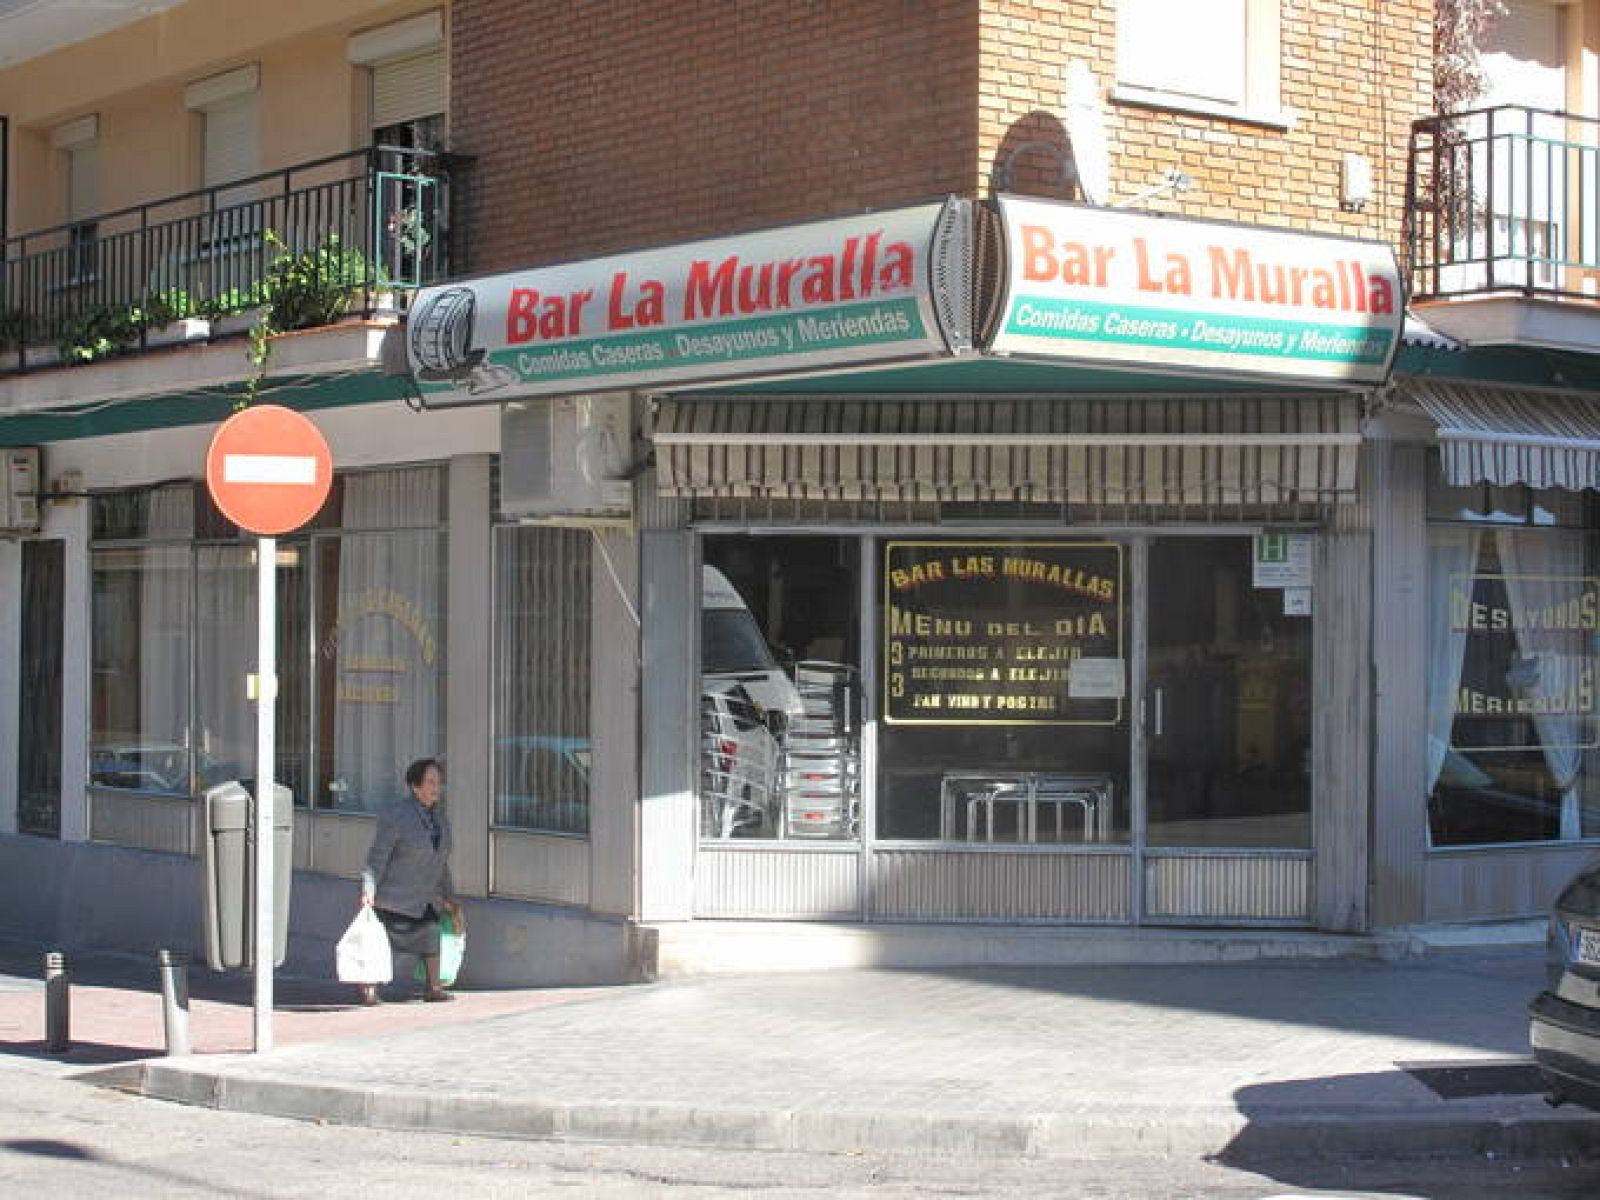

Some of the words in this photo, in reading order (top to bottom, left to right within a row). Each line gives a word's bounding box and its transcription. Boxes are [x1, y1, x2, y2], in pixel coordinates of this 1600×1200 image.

[507, 286, 593, 344] Bar
[608, 272, 664, 329] La
[685, 229, 914, 320] Muralla
[1021, 226, 1114, 288] Bar
[1134, 238, 1192, 295] La
[1208, 246, 1393, 315] Muralla
[519, 350, 589, 375] Comidas
[593, 340, 663, 365] Caseras
[676, 322, 779, 356] Desayunos
[782, 328, 795, 350] y
[799, 307, 910, 343] Meriendas
[1015, 303, 1099, 334] Comidas
[1104, 312, 1178, 340] Caseras
[1192, 319, 1283, 350] Desayunos
[1285, 335, 1296, 353] y
[891, 562, 943, 589] BAR
[953, 557, 994, 576] LAS
[1004, 558, 1113, 600] MURALLAS
[892, 606, 971, 636] MENU
[1055, 611, 1106, 636] DIA
